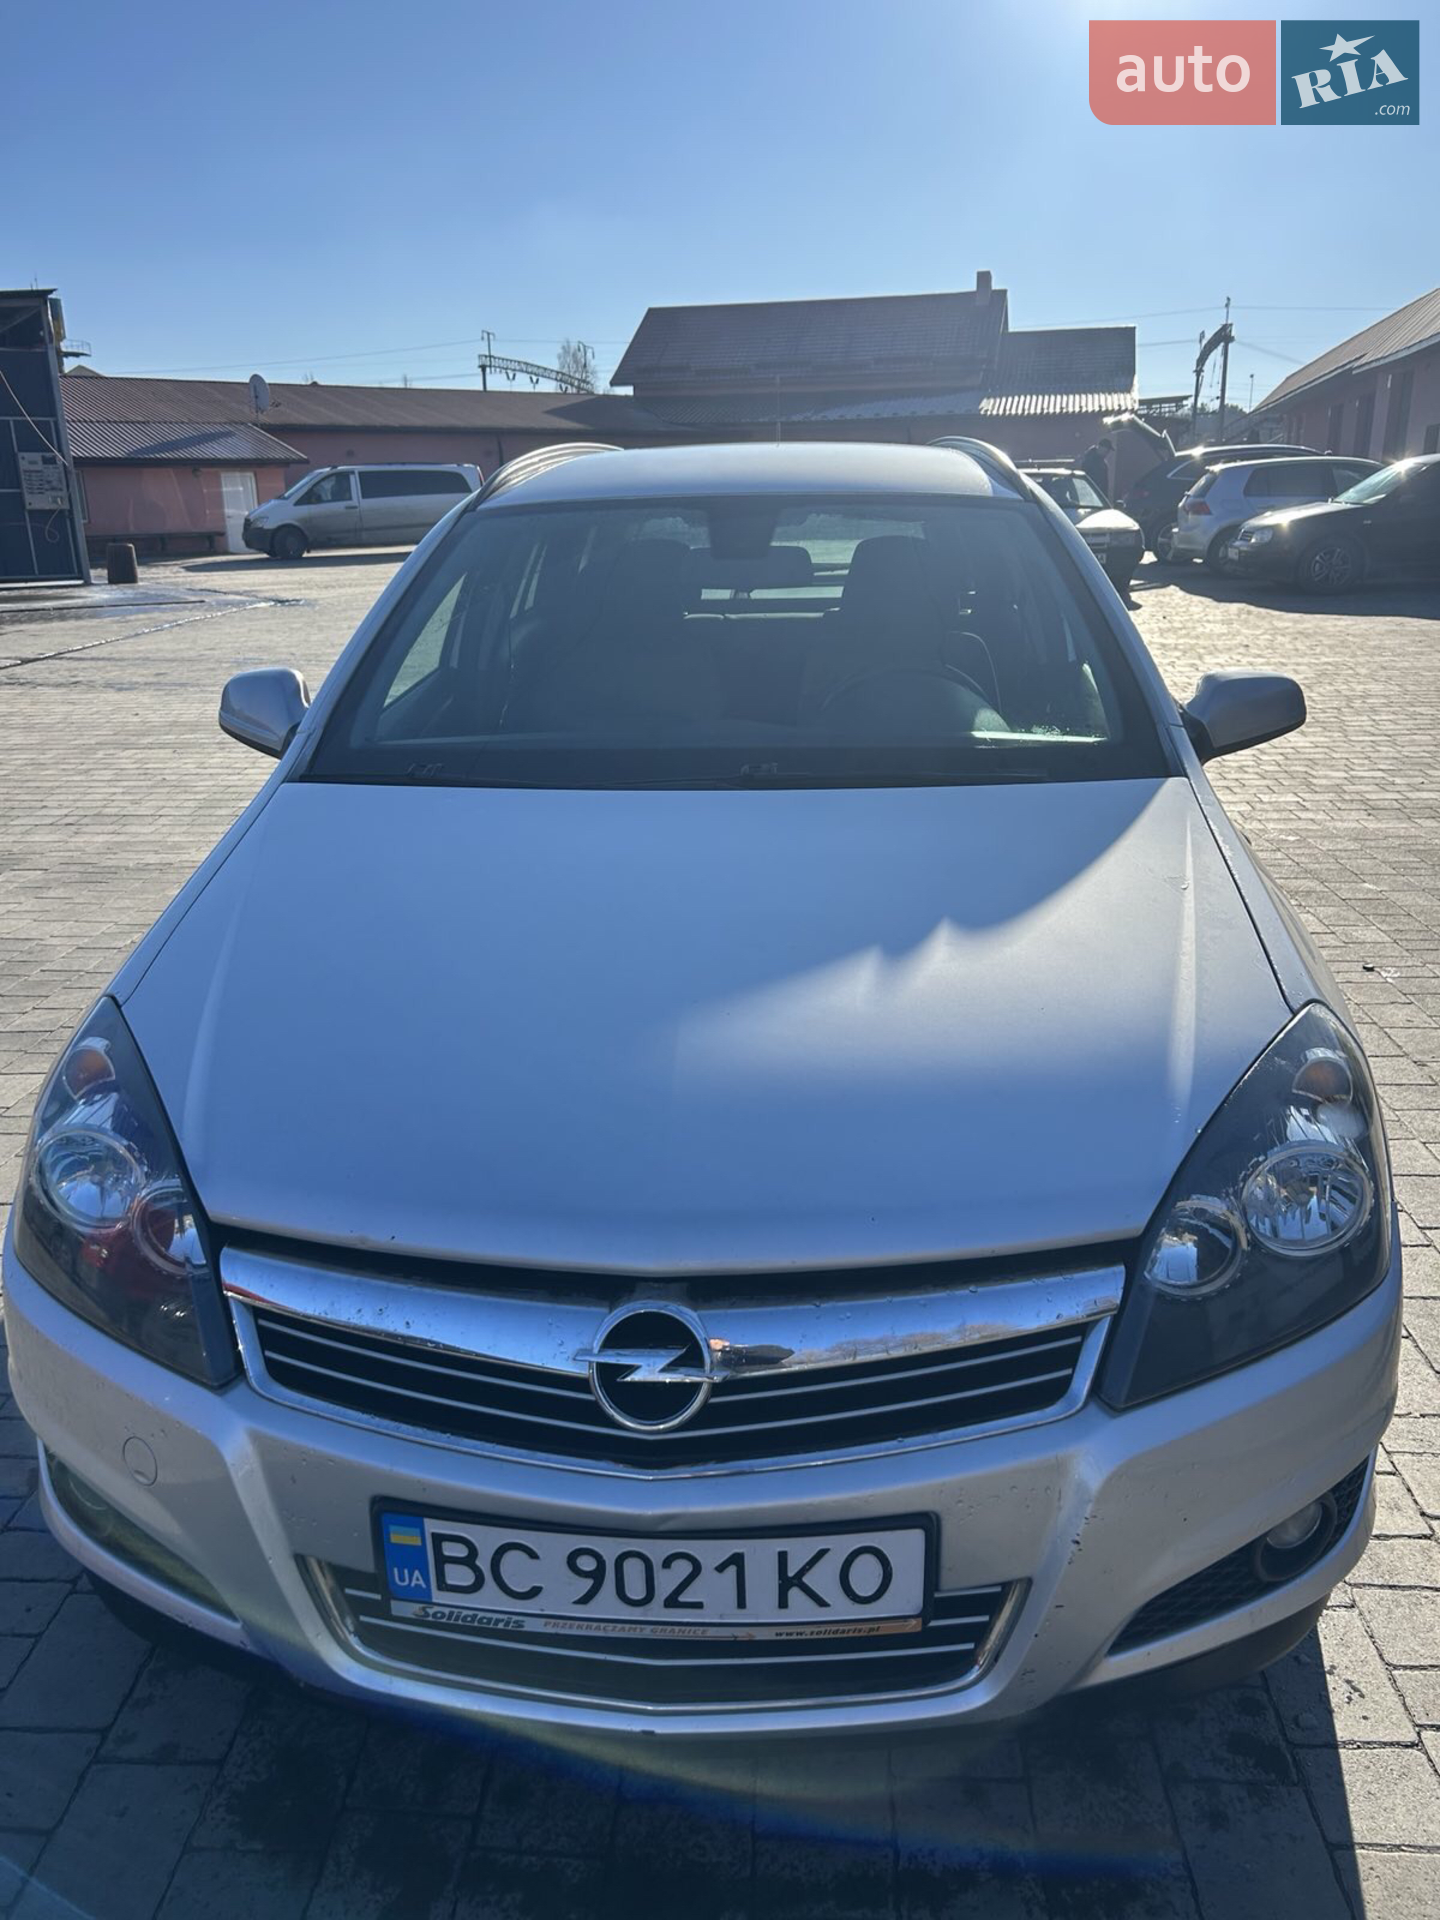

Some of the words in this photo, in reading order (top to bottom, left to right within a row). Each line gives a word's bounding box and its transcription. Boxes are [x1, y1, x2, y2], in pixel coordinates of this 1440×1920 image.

[393, 1567, 427, 1589] UA
[431, 1531, 544, 1601] BC
[566, 1546, 748, 1610] 9021
[777, 1544, 894, 1610] KO
[416, 1605, 526, 1630] Solidaris
[650, 1626, 710, 1636] GRANICE
[774, 1625, 881, 1638] www.solidaris.pl
